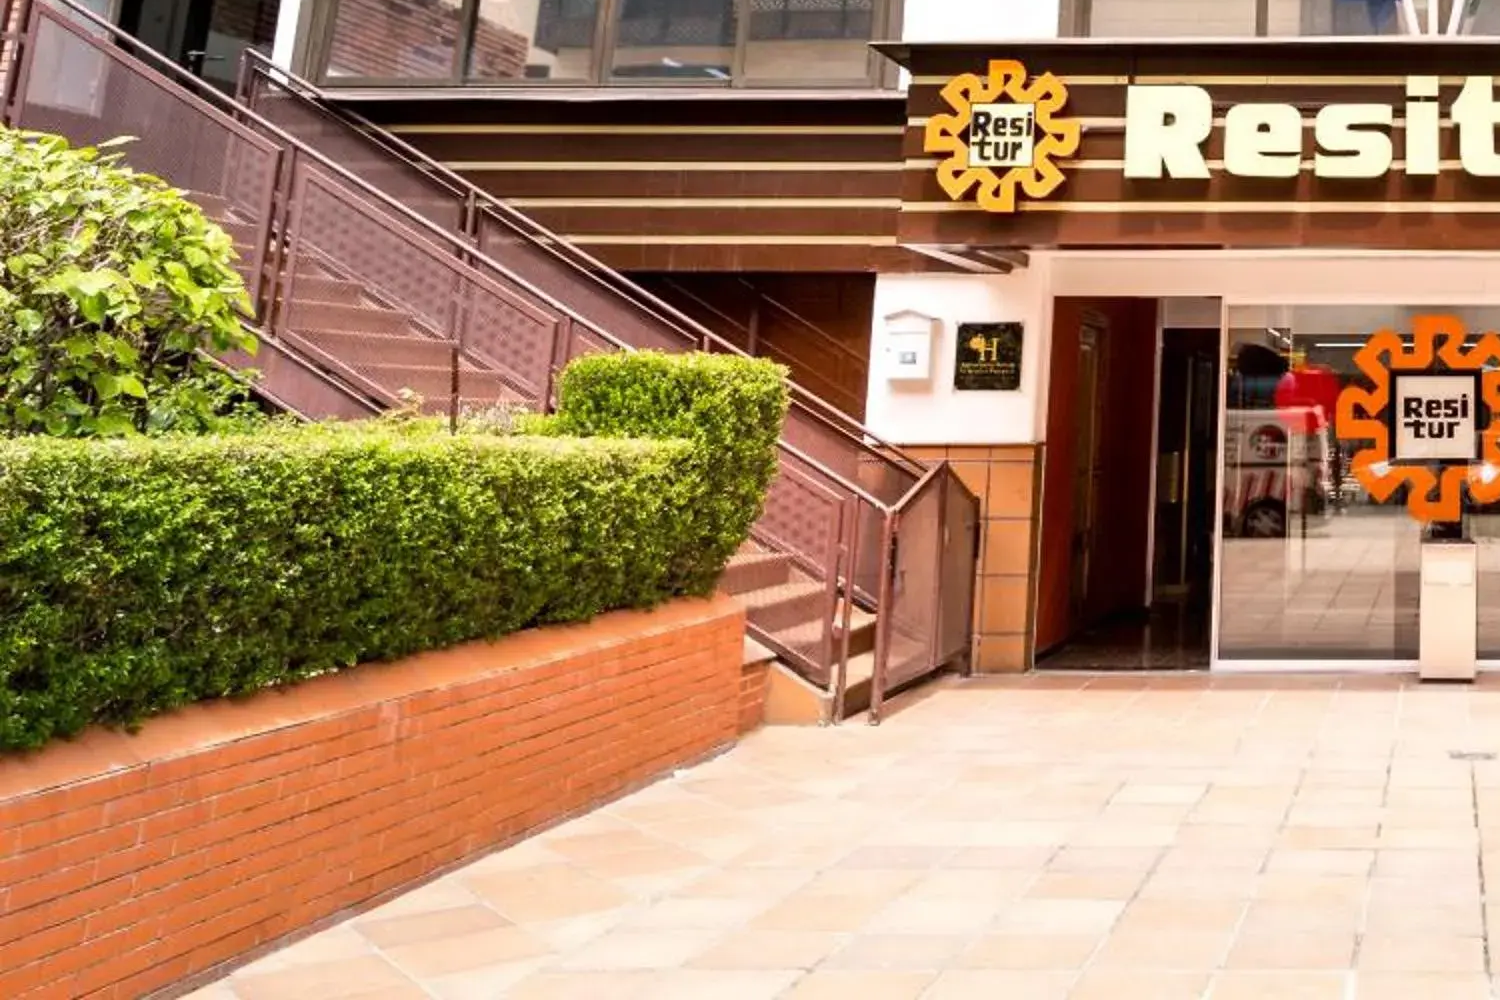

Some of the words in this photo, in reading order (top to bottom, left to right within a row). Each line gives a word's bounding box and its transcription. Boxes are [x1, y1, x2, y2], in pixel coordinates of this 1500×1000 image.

[971, 111, 1033, 137] Resi
[971, 136, 1023, 161] tur
[1403, 393, 1469, 419] Resi
[1403, 419, 1461, 439] tur
